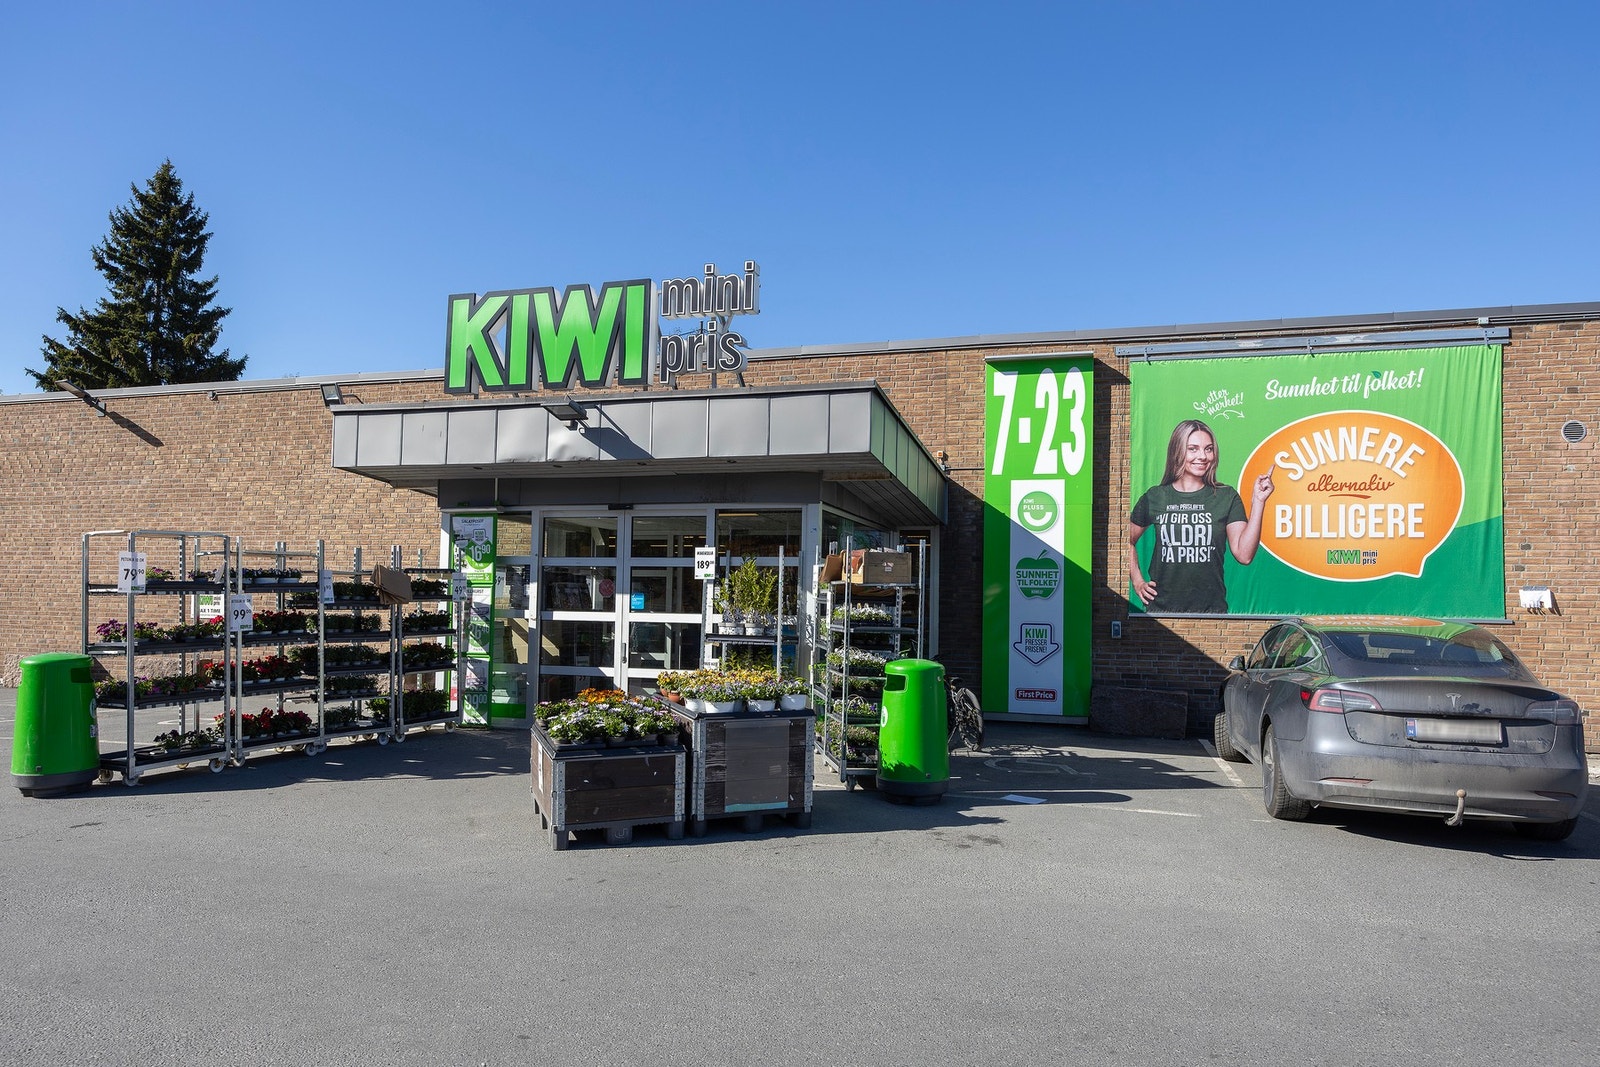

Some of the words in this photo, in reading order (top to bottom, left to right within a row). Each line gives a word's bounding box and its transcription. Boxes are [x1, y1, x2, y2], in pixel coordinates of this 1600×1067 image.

[661, 260, 755, 316] mini
[445, 279, 652, 394] KIWI
[660, 321, 746, 384] pris
[1265, 379, 1340, 400] Sunnhet
[1341, 373, 1362, 394] til
[1363, 368, 1425, 399] folket!
[1193, 401, 1208, 414] Se
[1206, 389, 1229, 404] etter
[1207, 392, 1244, 416] merket!
[992, 367, 1086, 476] 7-23
[1274, 426, 1426, 481] SUNNERE
[1307, 474, 1395, 492] alternativ
[1171, 513, 1188, 524] GIR
[1191, 512, 1212, 524] OSS
[1275, 503, 1425, 539] BILLIGERE
[1160, 524, 1213, 546] ALDRI
[1161, 543, 1175, 563] PÅ
[1327, 549, 1361, 565] KIWI
[1362, 557, 1377, 566] pris
[1016, 571, 1059, 579] SUNNHET
[1025, 628, 1047, 639] KIWI
[1018, 690, 1035, 698] First
[1035, 691, 1054, 699] Price
